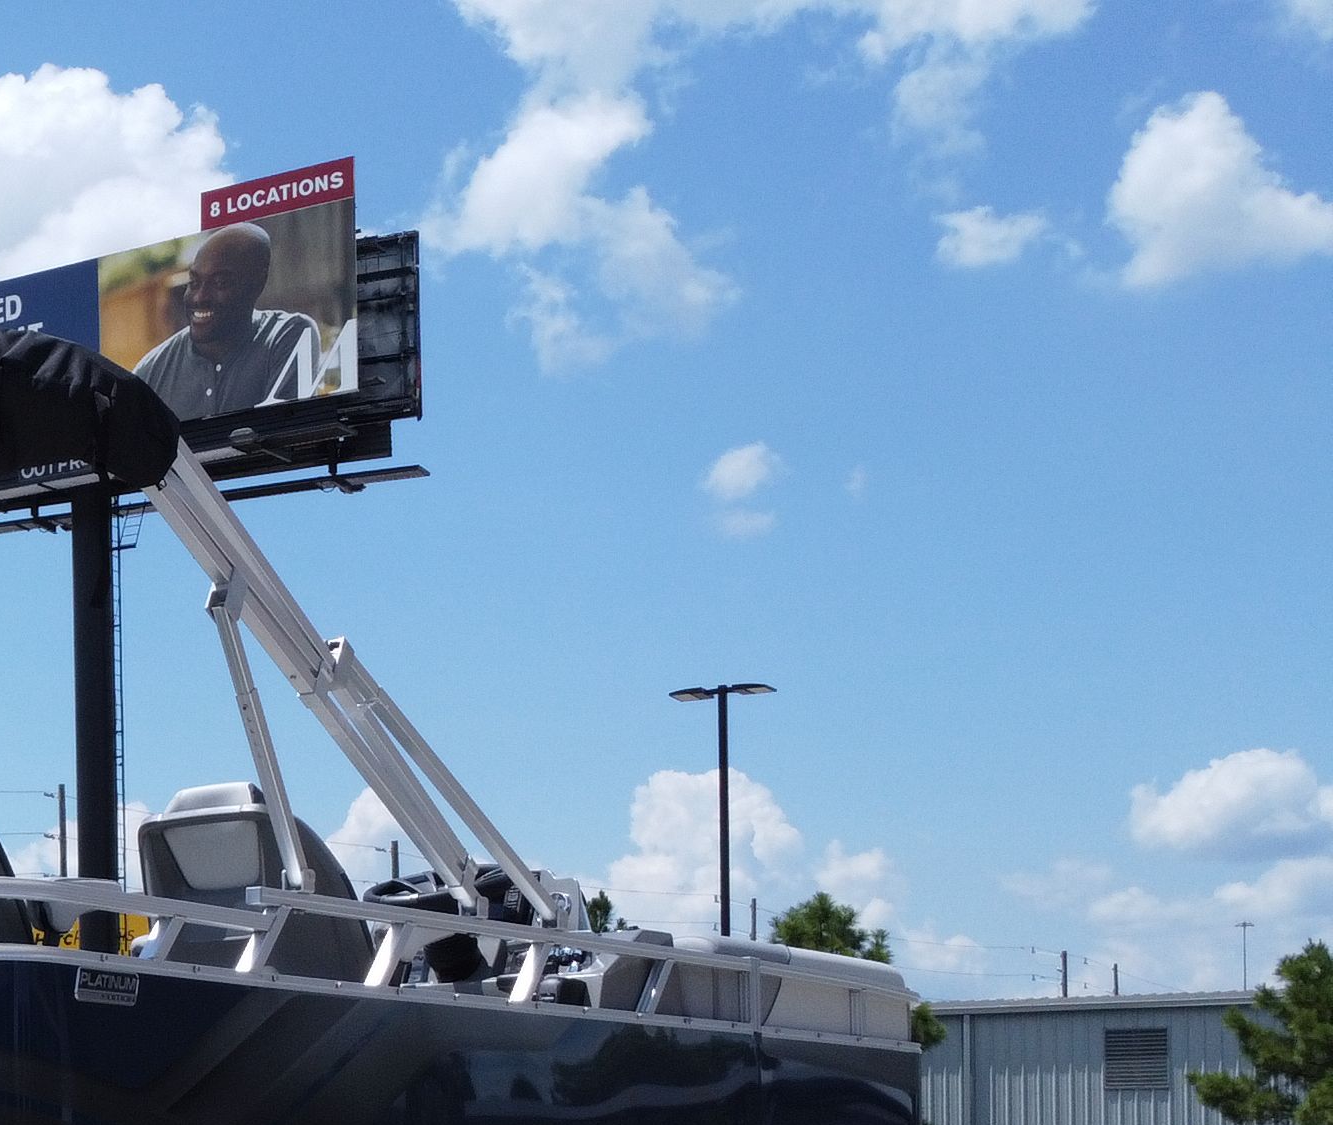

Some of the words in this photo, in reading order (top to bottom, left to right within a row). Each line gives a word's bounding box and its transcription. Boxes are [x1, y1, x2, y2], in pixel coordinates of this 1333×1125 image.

[209, 201, 221, 218] 8
[226, 171, 345, 214] LOCATIONS
[79, 970, 137, 993] PLATINUM
